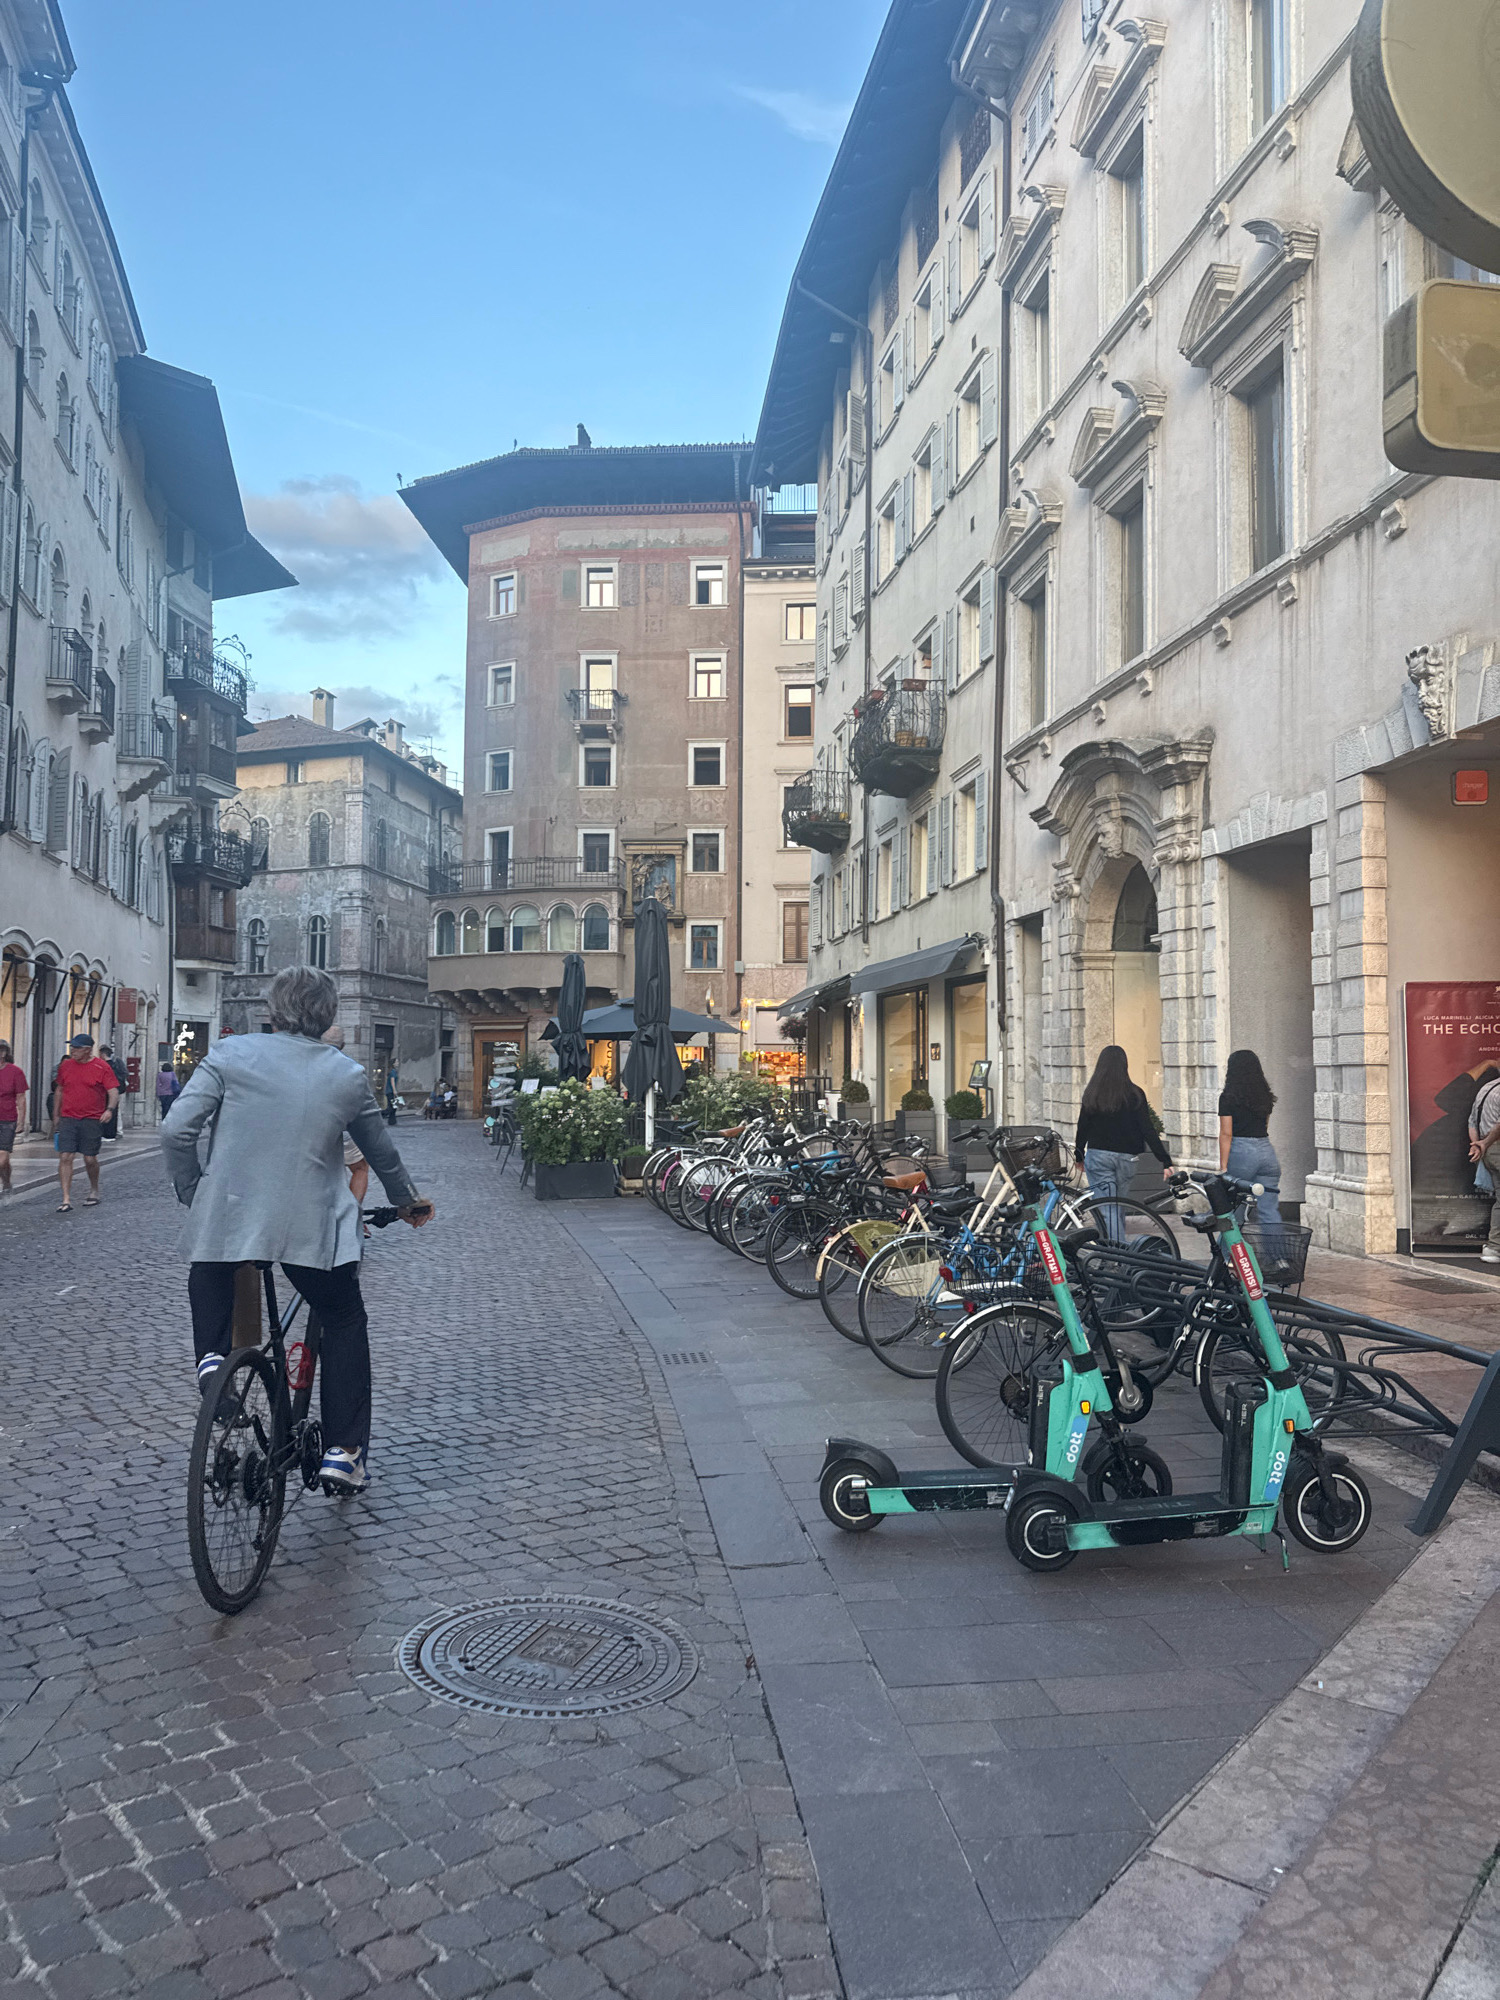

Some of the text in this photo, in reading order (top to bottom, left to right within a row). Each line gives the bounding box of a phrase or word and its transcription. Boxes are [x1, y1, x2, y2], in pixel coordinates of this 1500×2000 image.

[1423, 1024, 1453, 1034] THE
[1240, 1403, 1248, 1427] TIER
[1066, 1431, 1083, 1463] dott
[1269, 1450, 1286, 1484] dott
